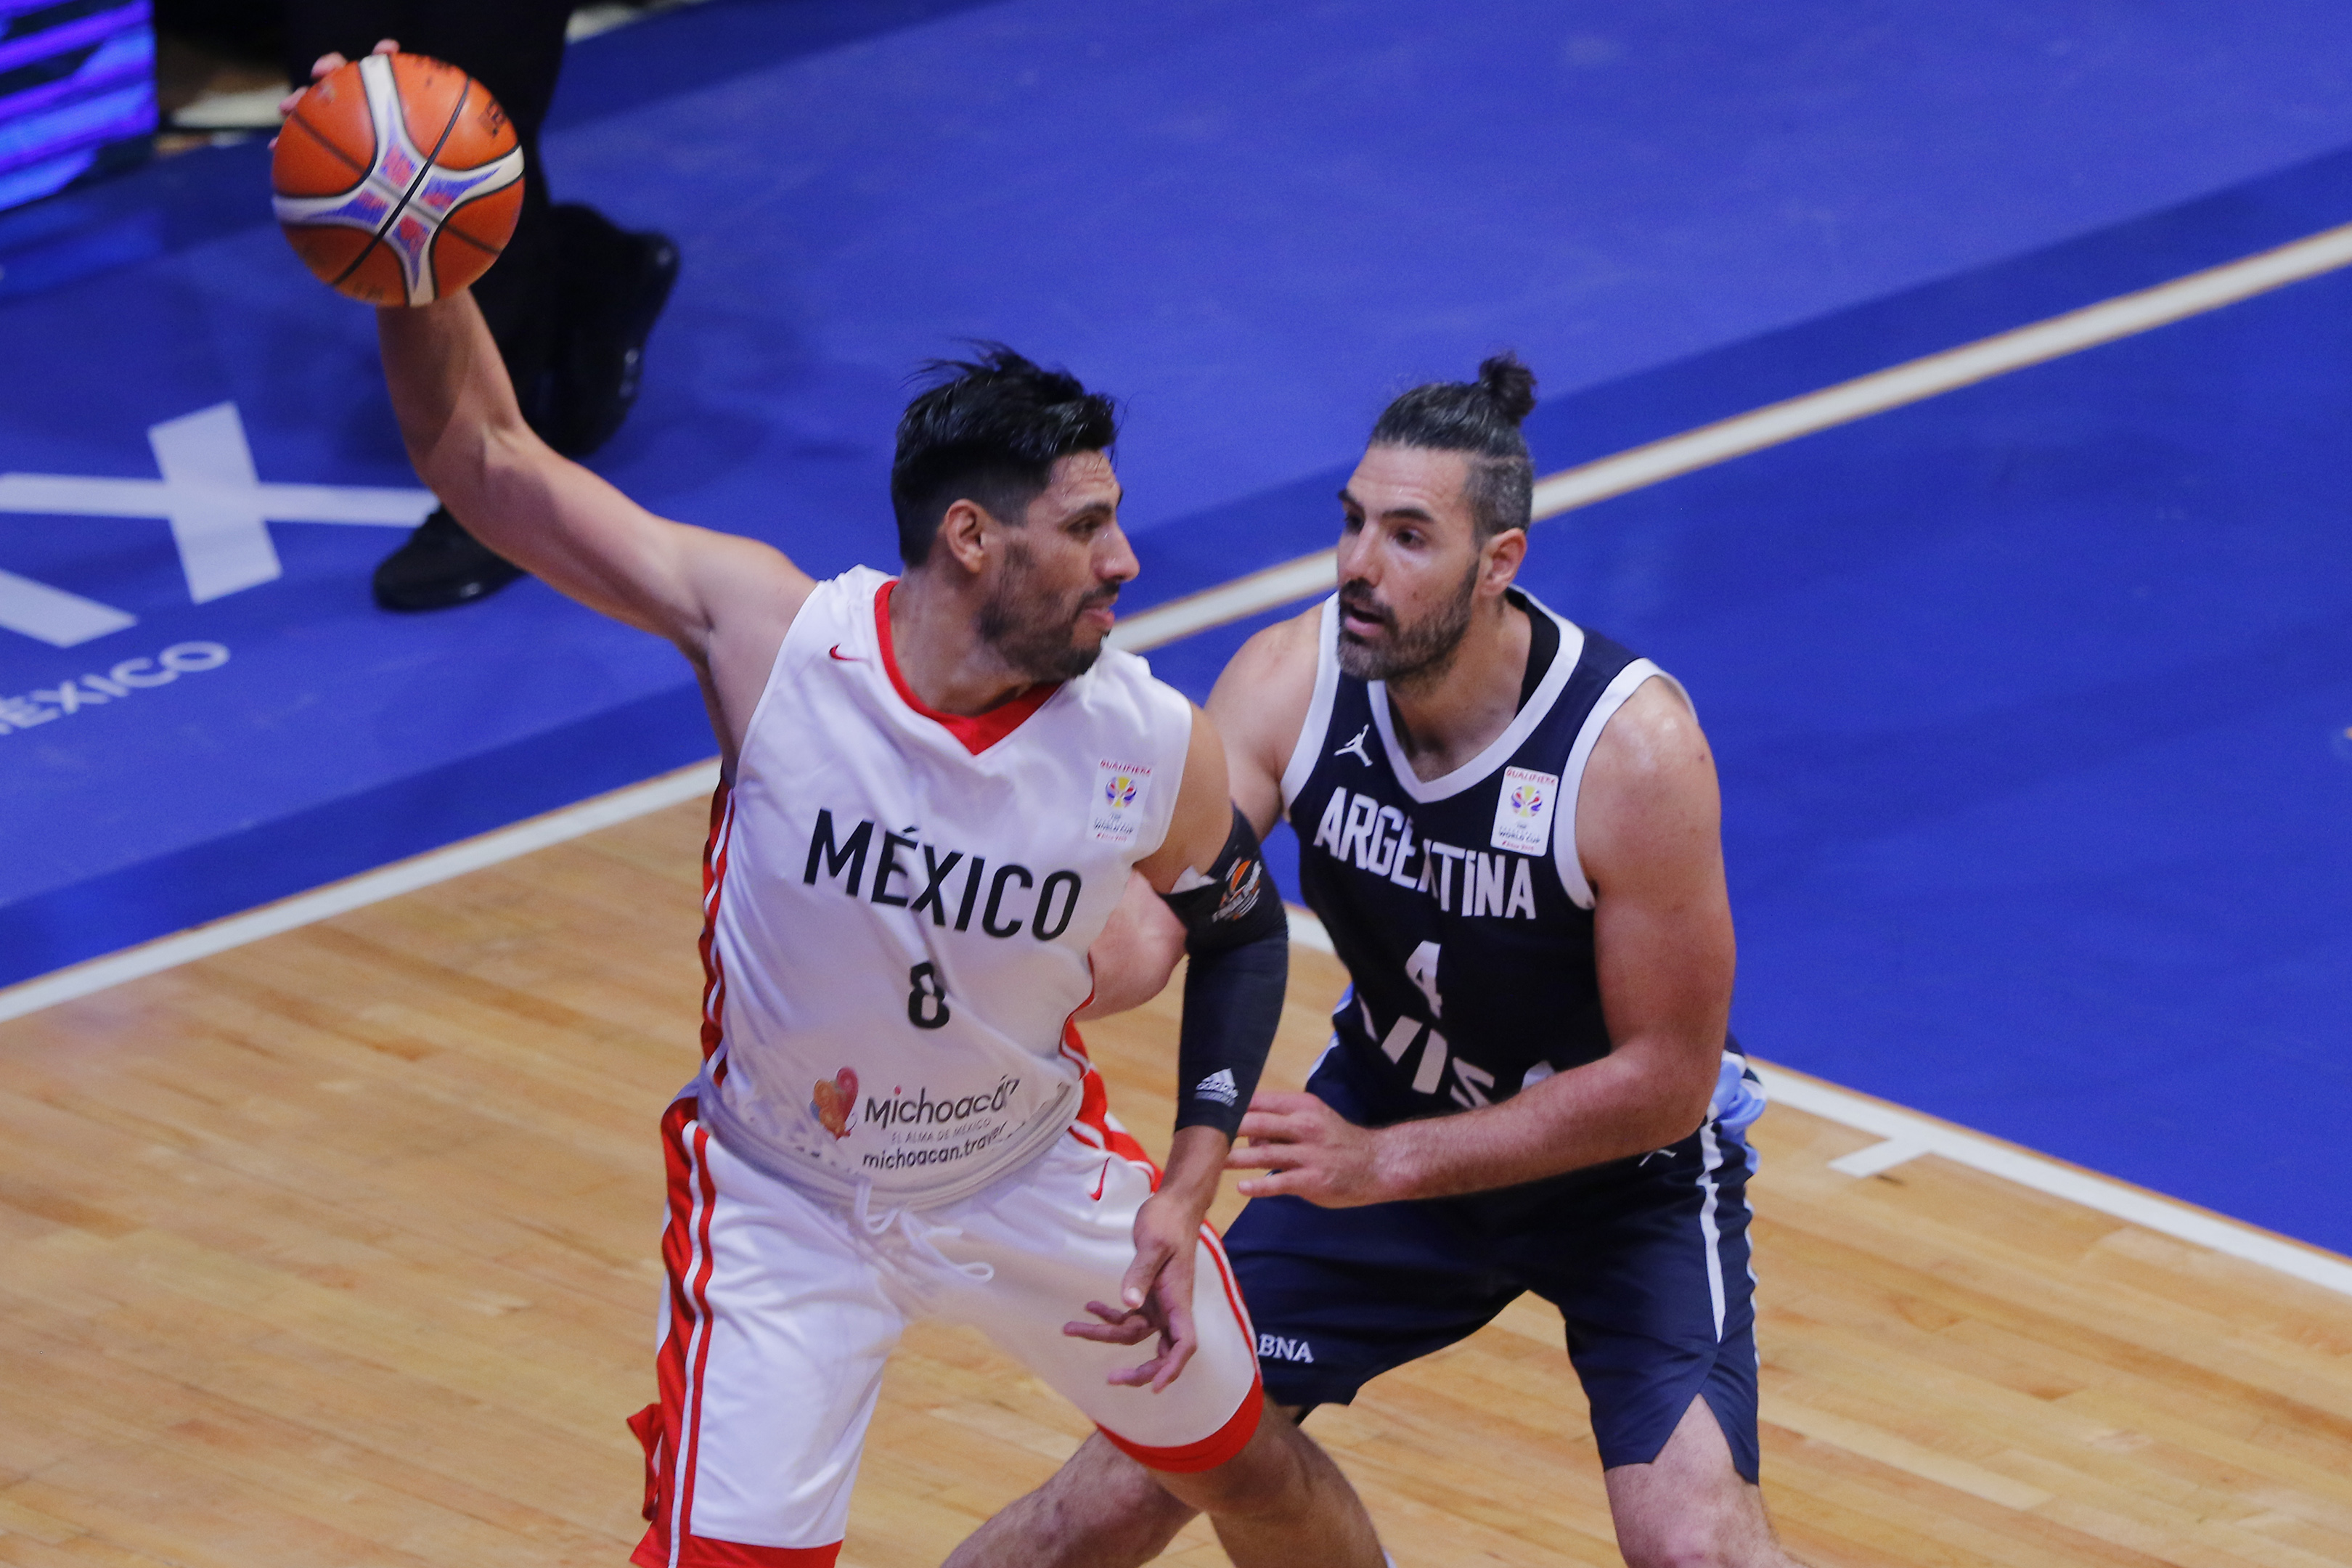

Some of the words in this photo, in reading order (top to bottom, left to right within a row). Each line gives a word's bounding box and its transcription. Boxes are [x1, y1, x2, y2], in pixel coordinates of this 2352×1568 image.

[0, 640, 231, 733] EXICO
[803, 807, 1082, 942] MÉXICO
[907, 962, 950, 1029] 8
[1405, 940, 1442, 1019] 4
[1257, 1333, 1315, 1364] BNA
